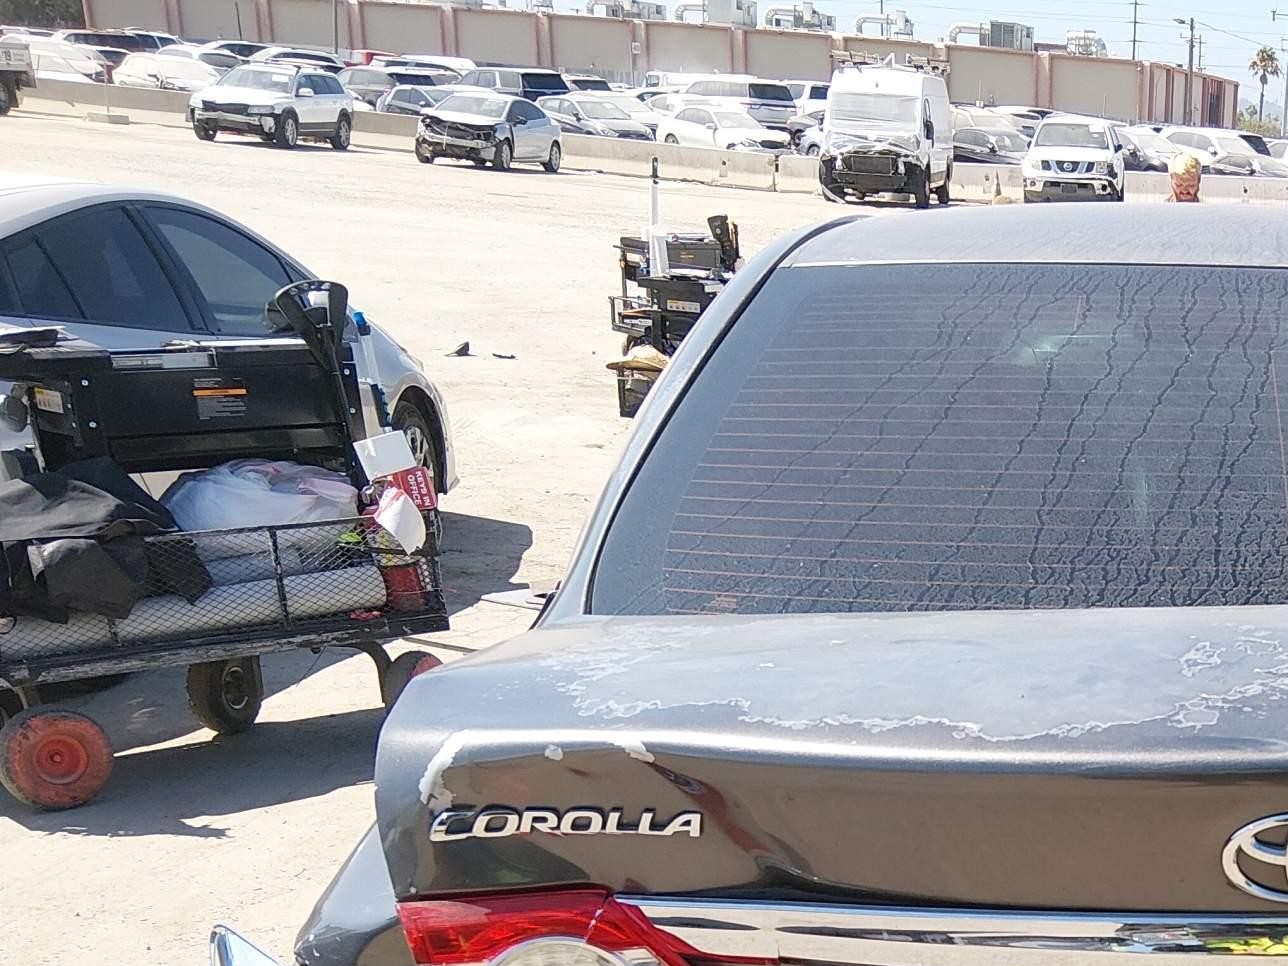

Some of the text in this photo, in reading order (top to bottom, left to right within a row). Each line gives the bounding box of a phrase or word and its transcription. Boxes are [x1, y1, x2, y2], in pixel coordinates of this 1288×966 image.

[407, 474, 423, 505] OFFICE
[415, 470, 431, 506] KEYS IN
[430, 806, 704, 842] COROLLA
